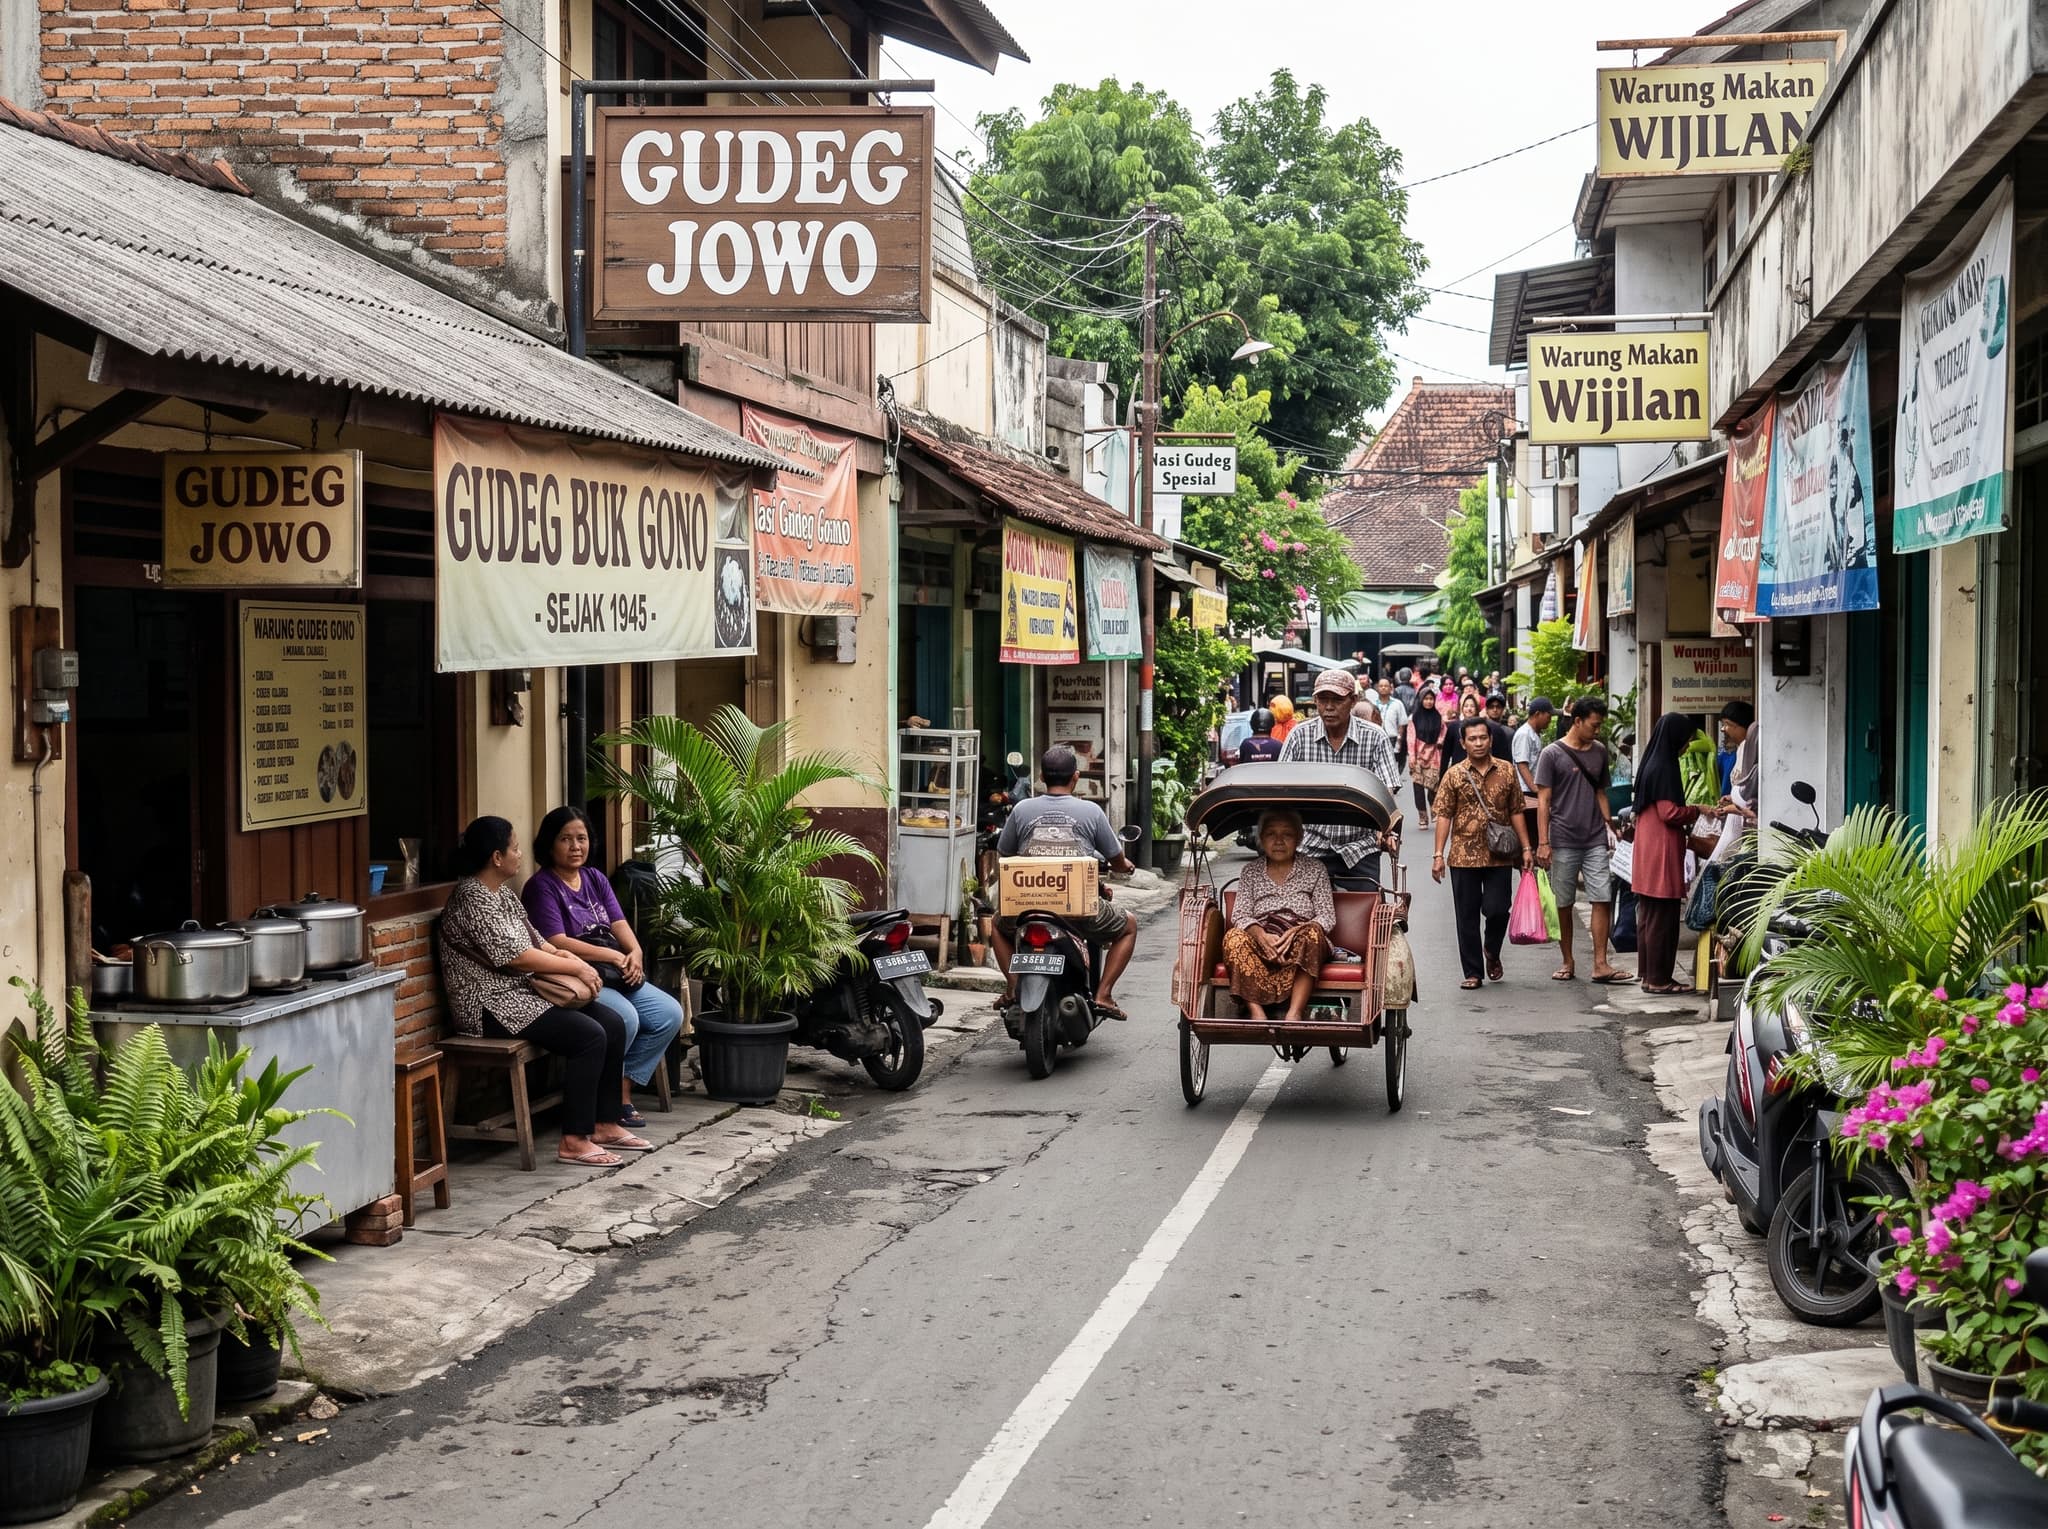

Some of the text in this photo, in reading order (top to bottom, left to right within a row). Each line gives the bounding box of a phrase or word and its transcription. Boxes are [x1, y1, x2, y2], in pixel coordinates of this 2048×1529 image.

[1609, 72, 1814, 108] Warung Makan
[1609, 111, 1813, 170] WIJILAN
[620, 129, 909, 205] GUDEG
[646, 220, 878, 296] JOWO
[1541, 343, 1698, 372] Warung Makan
[1538, 377, 1701, 435] Wijilan
[1184, 452, 1231, 471] Gudeg
[175, 465, 345, 507] GUDEG
[1162, 472, 1216, 490] Spesial
[446, 462, 708, 572] GUDEG BUK GONO
[189, 521, 331, 564] JOWO
[254, 618, 355, 640] WARUNG GUDEG GONO
[546, 593, 605, 633] SEJAK
[610, 594, 647, 631] 1945
[1673, 645, 1720, 660] Warung
[1694, 660, 1738, 676] Wijilan
[1012, 870, 1066, 891] Gudeg
